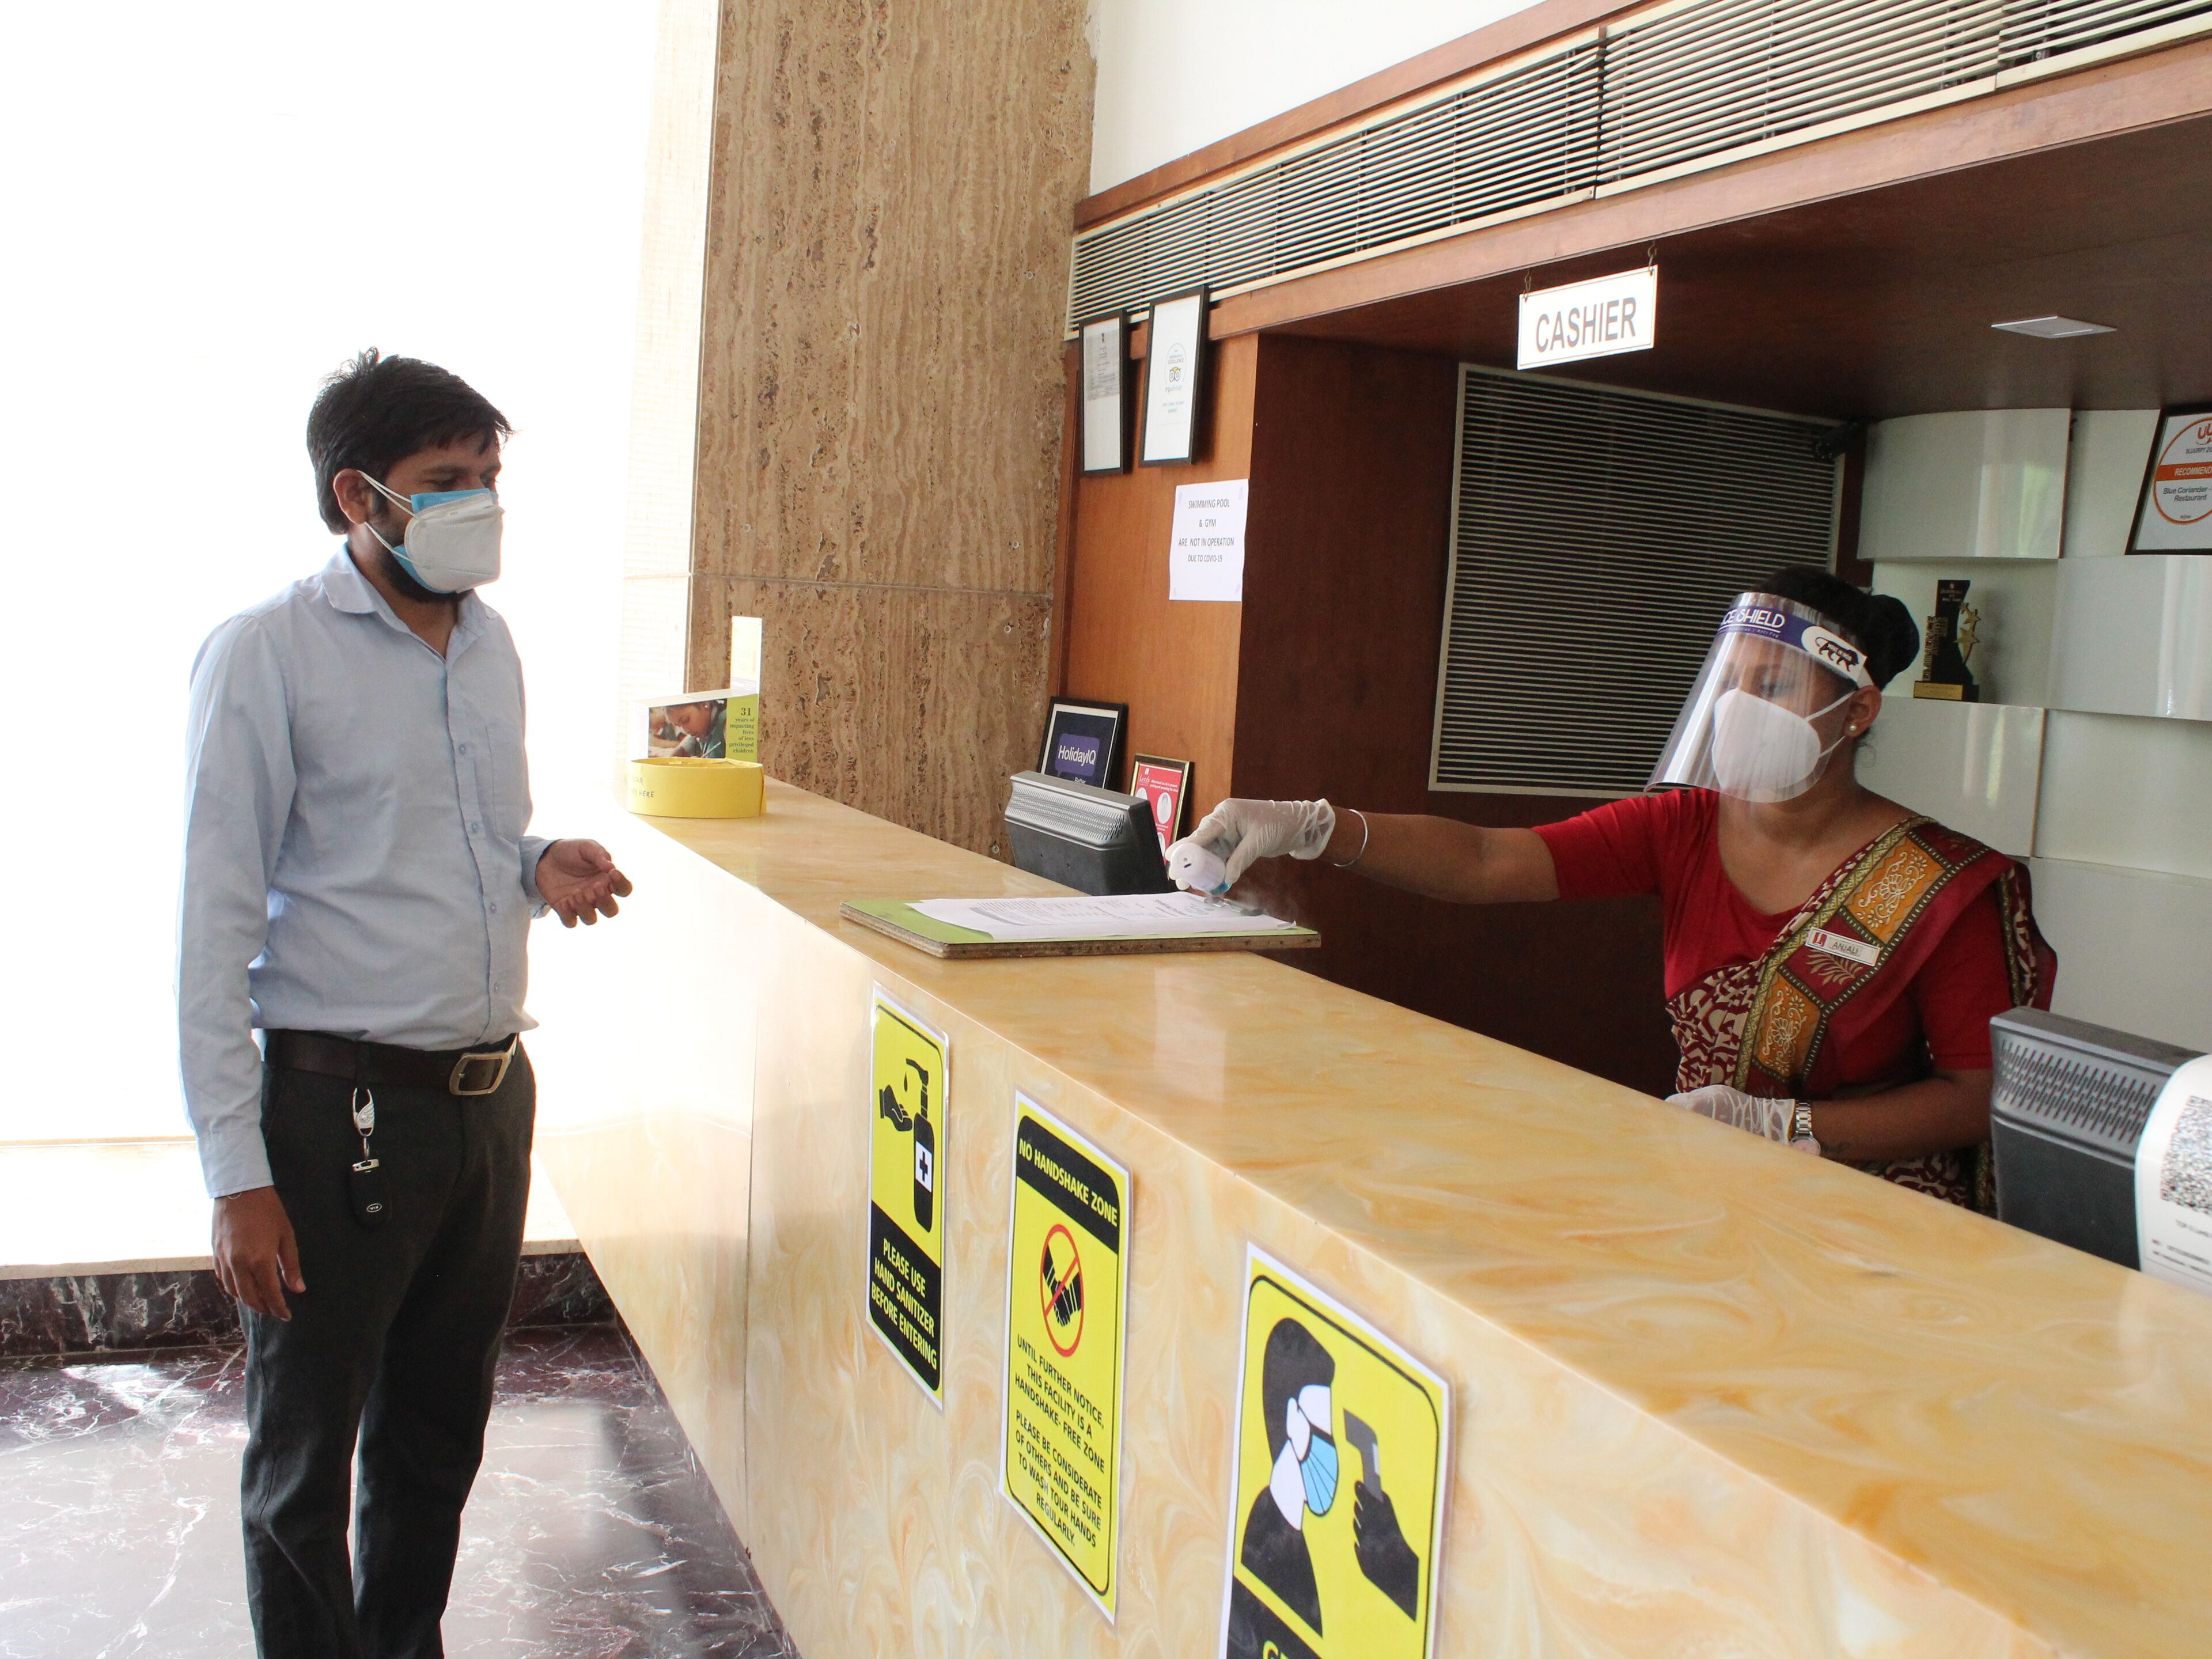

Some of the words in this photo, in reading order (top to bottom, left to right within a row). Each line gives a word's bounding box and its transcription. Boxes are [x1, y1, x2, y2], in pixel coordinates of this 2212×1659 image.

[1536, 297, 1636, 353] CASHIER
[2175, 466, 2212, 476] RECOMMEND
[1188, 499, 1215, 509] SWIMMING
[1217, 499, 1230, 507] POOL
[1205, 519, 1216, 527] GYM
[1178, 538, 1187, 546] ARE
[1190, 538, 1200, 546] NOT
[1201, 538, 1206, 546] IN
[1207, 537, 1234, 546] OPERATION
[1736, 608, 1785, 628] SHIELD
[741, 707, 751, 715] 31
[1058, 745, 1096, 766] HolidayIQ
[639, 789, 655, 798] HERE
[1019, 1138, 1032, 1161] NO
[1034, 1149, 1089, 1205] HANDSHAKE
[1090, 1191, 1118, 1227] ZONE
[883, 1237, 909, 1281] PLEASE
[911, 1267, 926, 1298] USE
[872, 1281, 897, 1326] BEFORE
[899, 1312, 937, 1370] ENTERING
[874, 1257, 895, 1293] HAND
[896, 1281, 934, 1338] SANITIZER
[1017, 1334, 1037, 1363] UNTIL
[1039, 1355, 1071, 1396] FURTHER
[1074, 1388, 1104, 1430] NOTICE,
[1027, 1363, 1042, 1388] THIS
[1044, 1381, 1075, 1421] FACILITY
[1078, 1413, 1084, 1430] IS
[1086, 1423, 1093, 1439] A
[1015, 1373, 1061, 1426] HANDSHAKE-
[1063, 1421, 1081, 1450] FREE
[1084, 1441, 1105, 1474] ZONE
[1016, 1409, 1040, 1444] PLEASE
[1042, 1436, 1051, 1455] BE
[1052, 1448, 1102, 1510] CONSIDERATE
[1016, 1430, 1024, 1446] OF
[1027, 1441, 1051, 1477] OTHERS
[1054, 1471, 1069, 1495] AND
[1071, 1488, 1080, 1508] BE
[1081, 1501, 1101, 1532] SURE
[1018, 1452, 1028, 1470] TO
[1029, 1463, 1048, 1495] WASH
[1050, 1487, 1069, 1518] TOUR
[1070, 1510, 1096, 1548] HANDS
[1036, 1493, 1075, 1547] REGULARLY.
